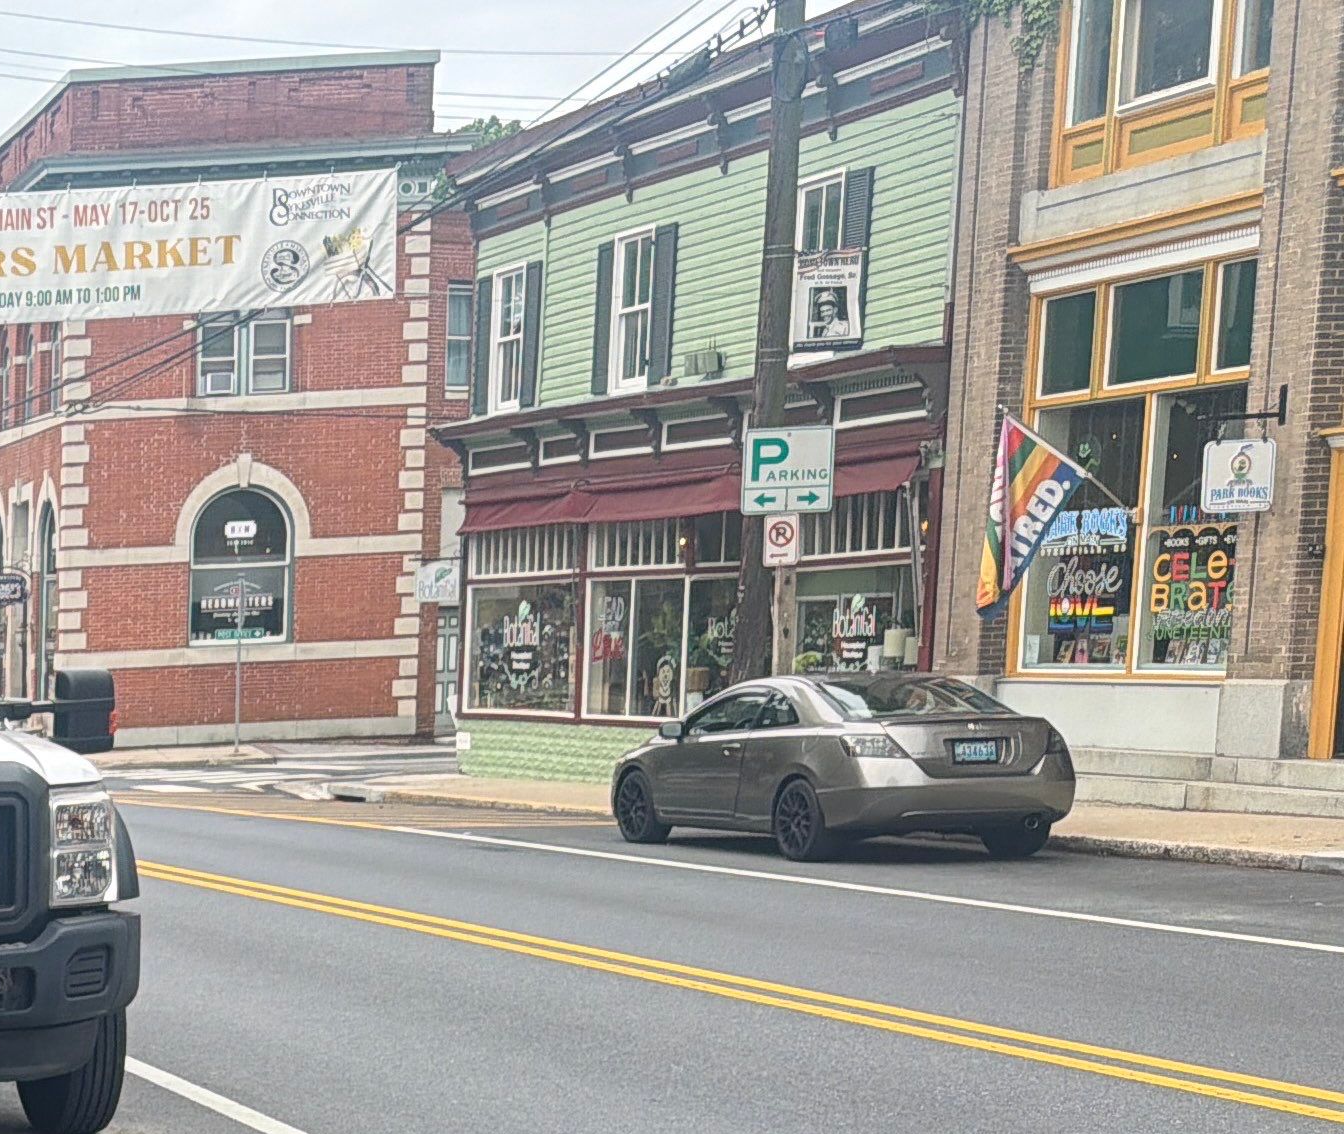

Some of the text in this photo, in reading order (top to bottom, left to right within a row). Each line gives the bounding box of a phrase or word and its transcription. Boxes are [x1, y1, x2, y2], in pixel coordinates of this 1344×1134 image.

[273, 183, 350, 204] DOWNTOWN
[36, 206, 57, 230] ST
[73, 203, 111, 227] MAY
[119, 199, 181, 224] 17-OCT
[189, 197, 210, 221] 25
[270, 206, 350, 226] CONNECTION
[53, 234, 242, 275] MARKET
[25, 290, 52, 307] 9:00
[55, 289, 73, 305] AM
[77, 287, 91, 304] TO
[95, 286, 119, 303] 1:00
[123, 284, 141, 301] PM
[751, 438, 829, 482] PARKING
[1210, 487, 1235, 502] PARK
[1047, 555, 1123, 597] Choose
[1146, 625, 1230, 641] JUNETEENT
